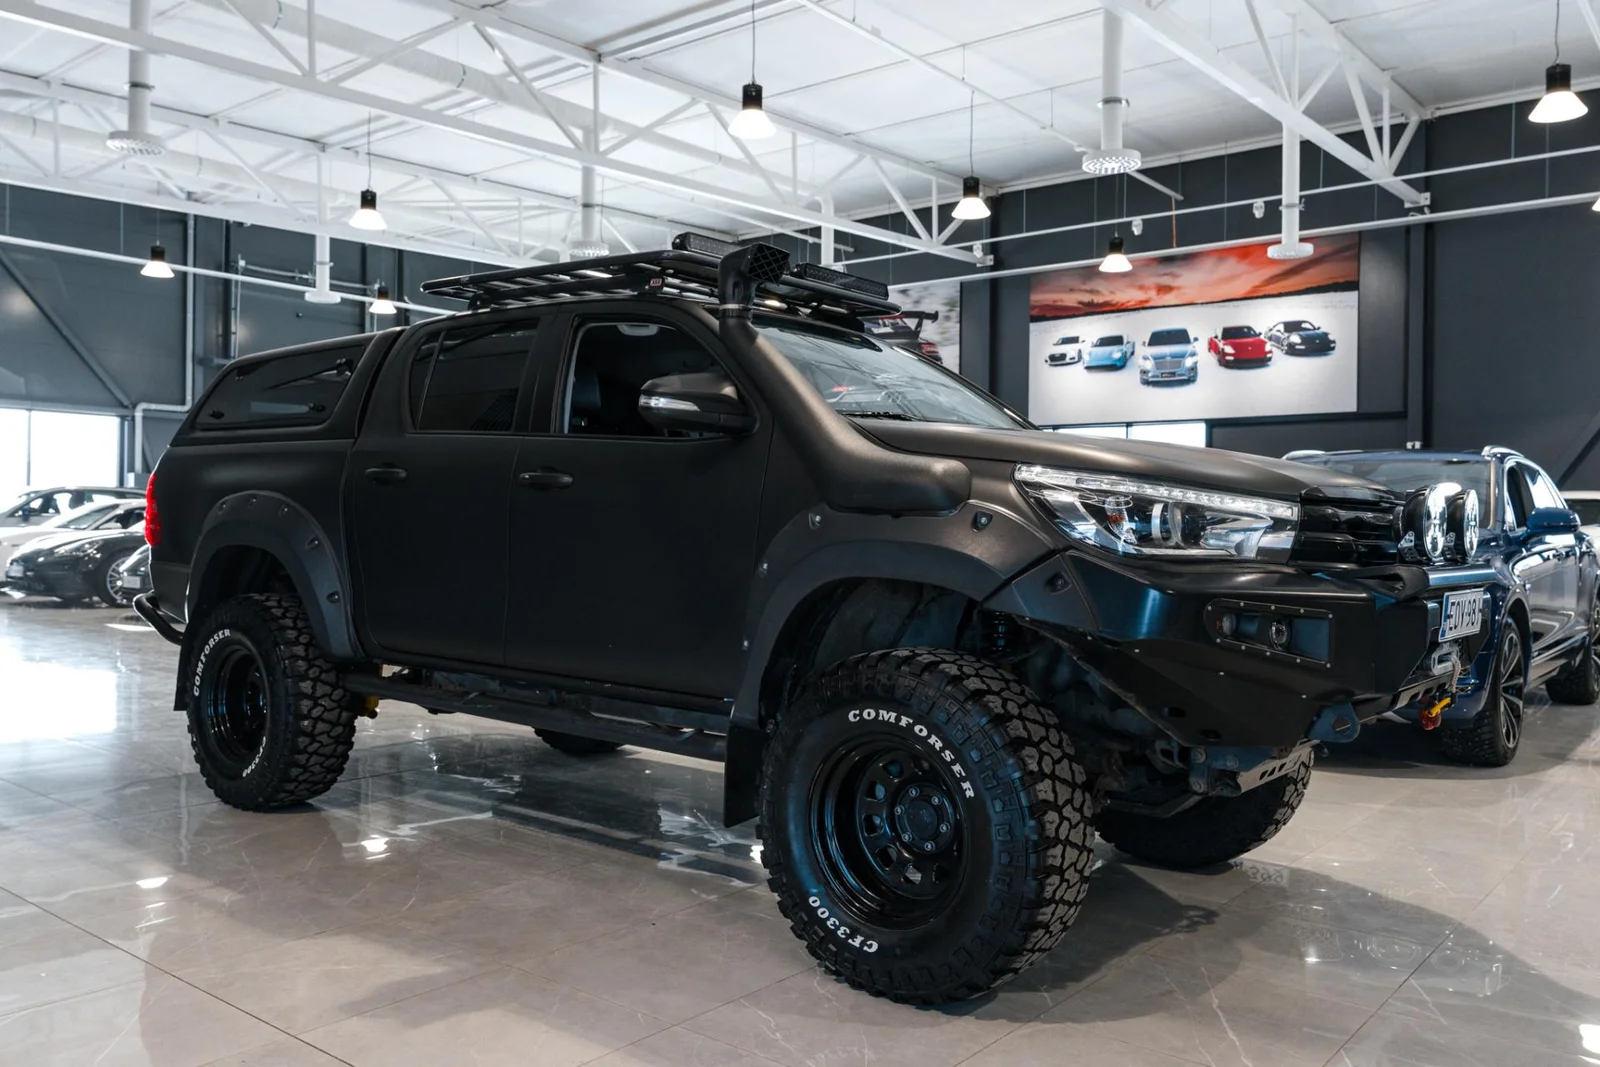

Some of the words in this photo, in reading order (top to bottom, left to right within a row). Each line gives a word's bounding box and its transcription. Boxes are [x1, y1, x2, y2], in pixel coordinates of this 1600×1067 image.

[193, 628, 232, 697] COMFORSER
[848, 707, 976, 799] COMFORSER
[808, 895, 880, 953] CF3300
